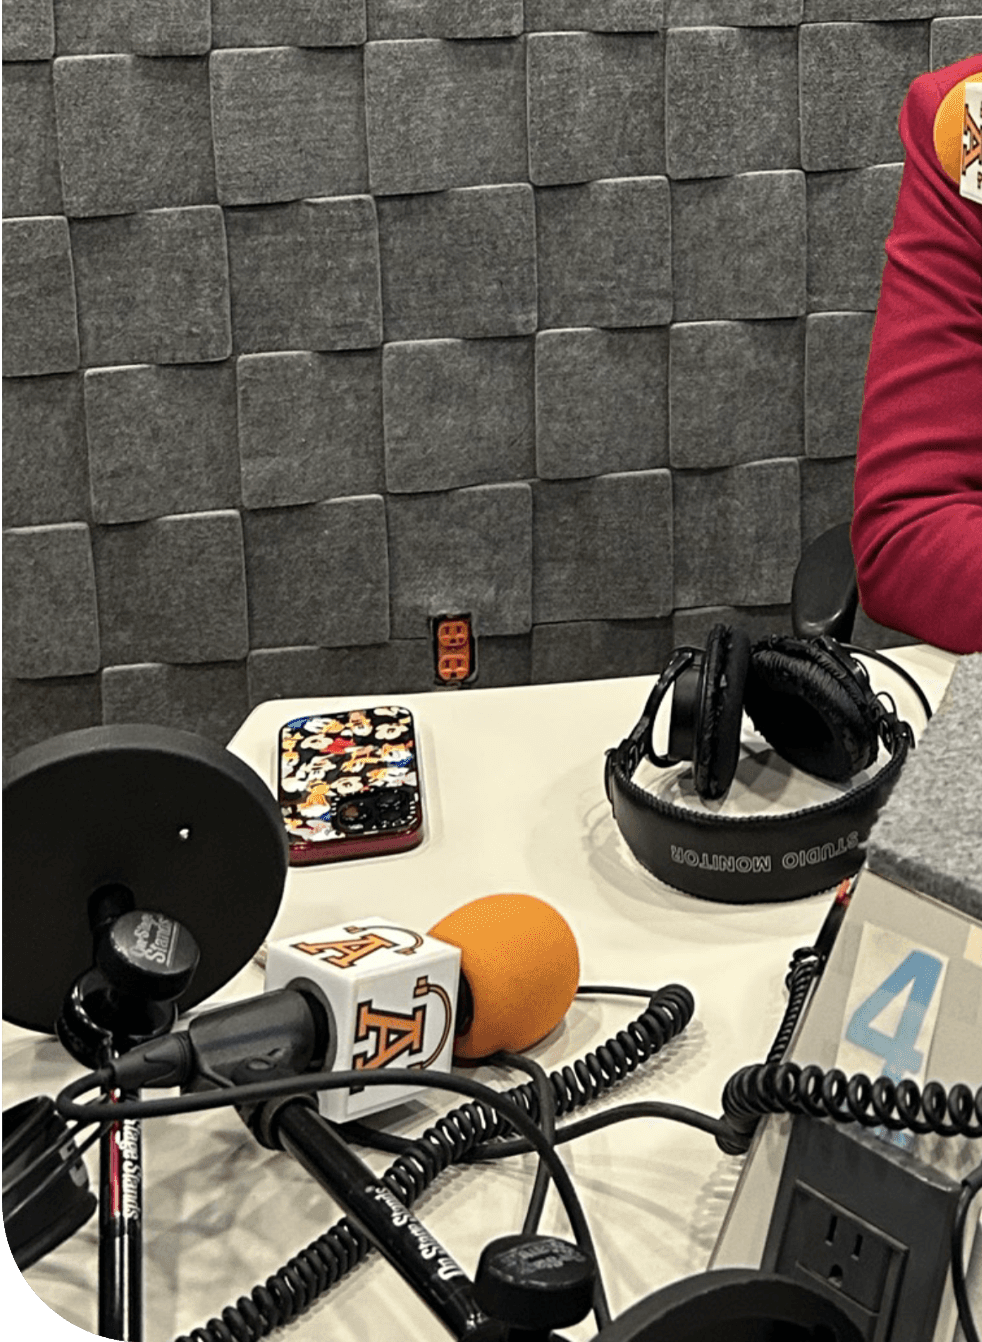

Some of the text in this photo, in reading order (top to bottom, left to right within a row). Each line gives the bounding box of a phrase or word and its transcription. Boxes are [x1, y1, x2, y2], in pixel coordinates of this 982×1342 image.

[670, 831, 859, 873] STUDIO MONITOR
[289, 933, 400, 969] A
[845, 948, 944, 1084] 4
[122, 1160, 141, 1220] Stands
